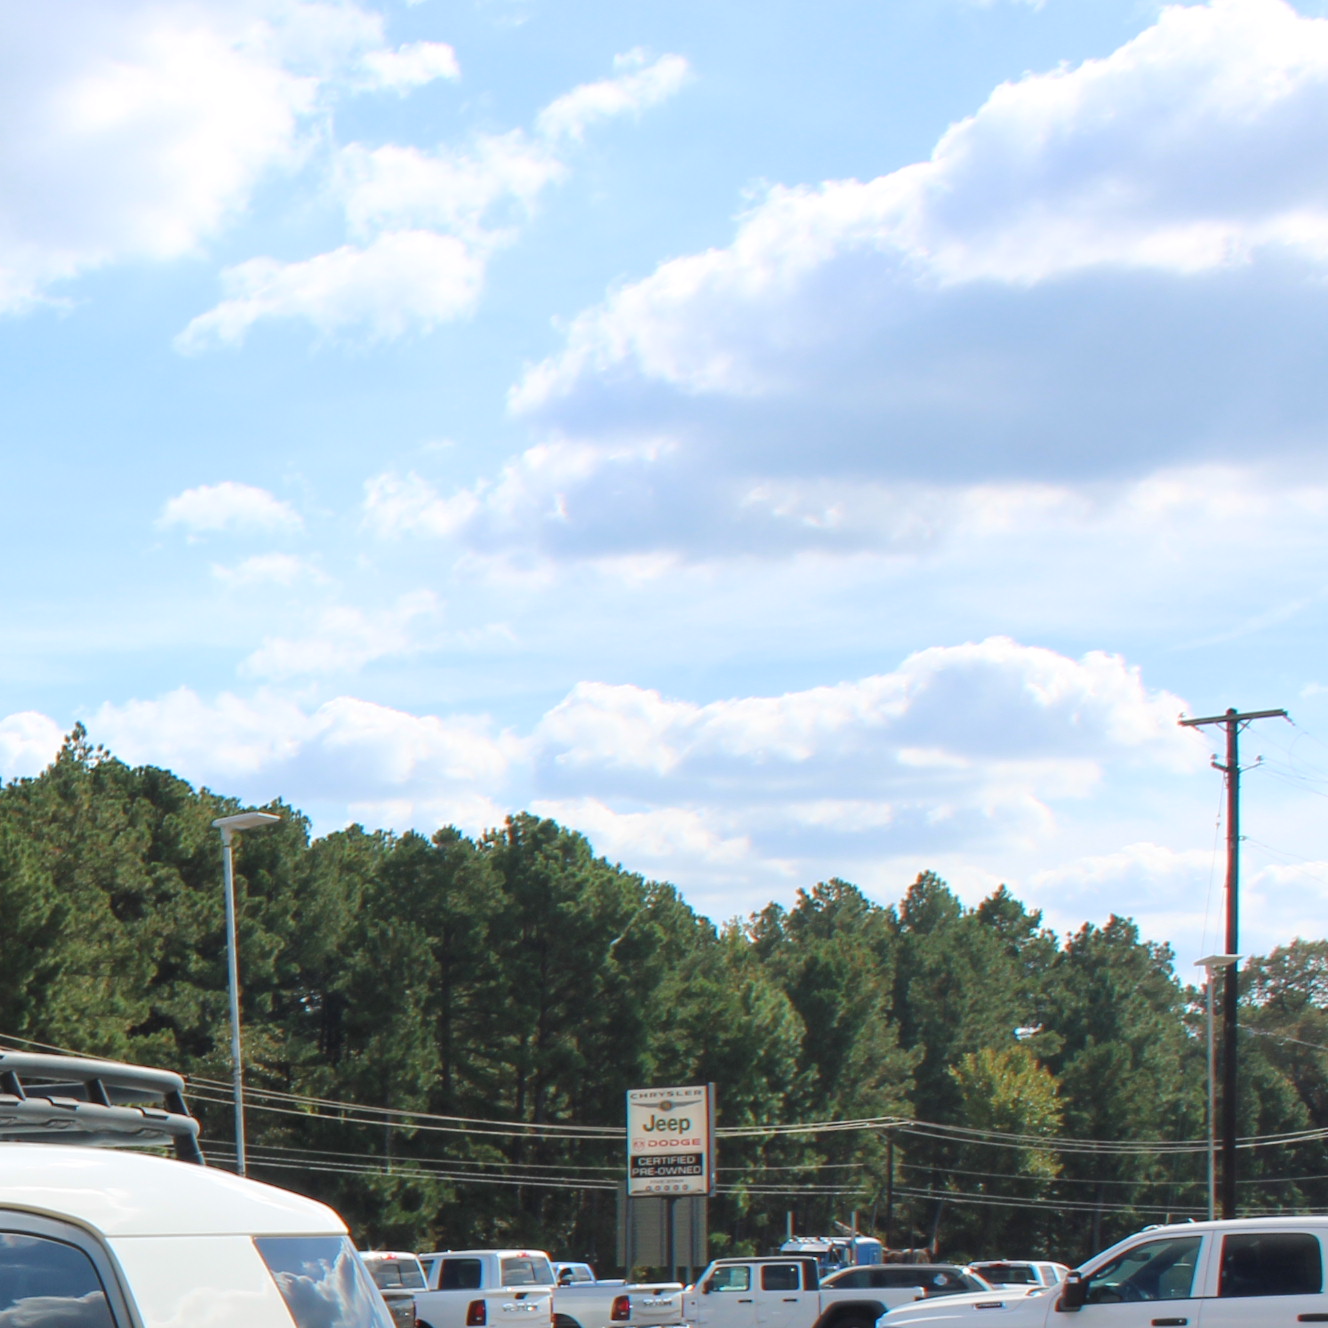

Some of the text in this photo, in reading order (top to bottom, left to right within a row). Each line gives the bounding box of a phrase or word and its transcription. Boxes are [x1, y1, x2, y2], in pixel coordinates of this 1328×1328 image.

[630, 1089, 702, 1100] CHRYSLER
[642, 1114, 690, 1134] Jeep
[648, 1138, 700, 1147] DODGE
[638, 1155, 695, 1165] CERTIFIED
[632, 1165, 701, 1176] PRE-OWNED
